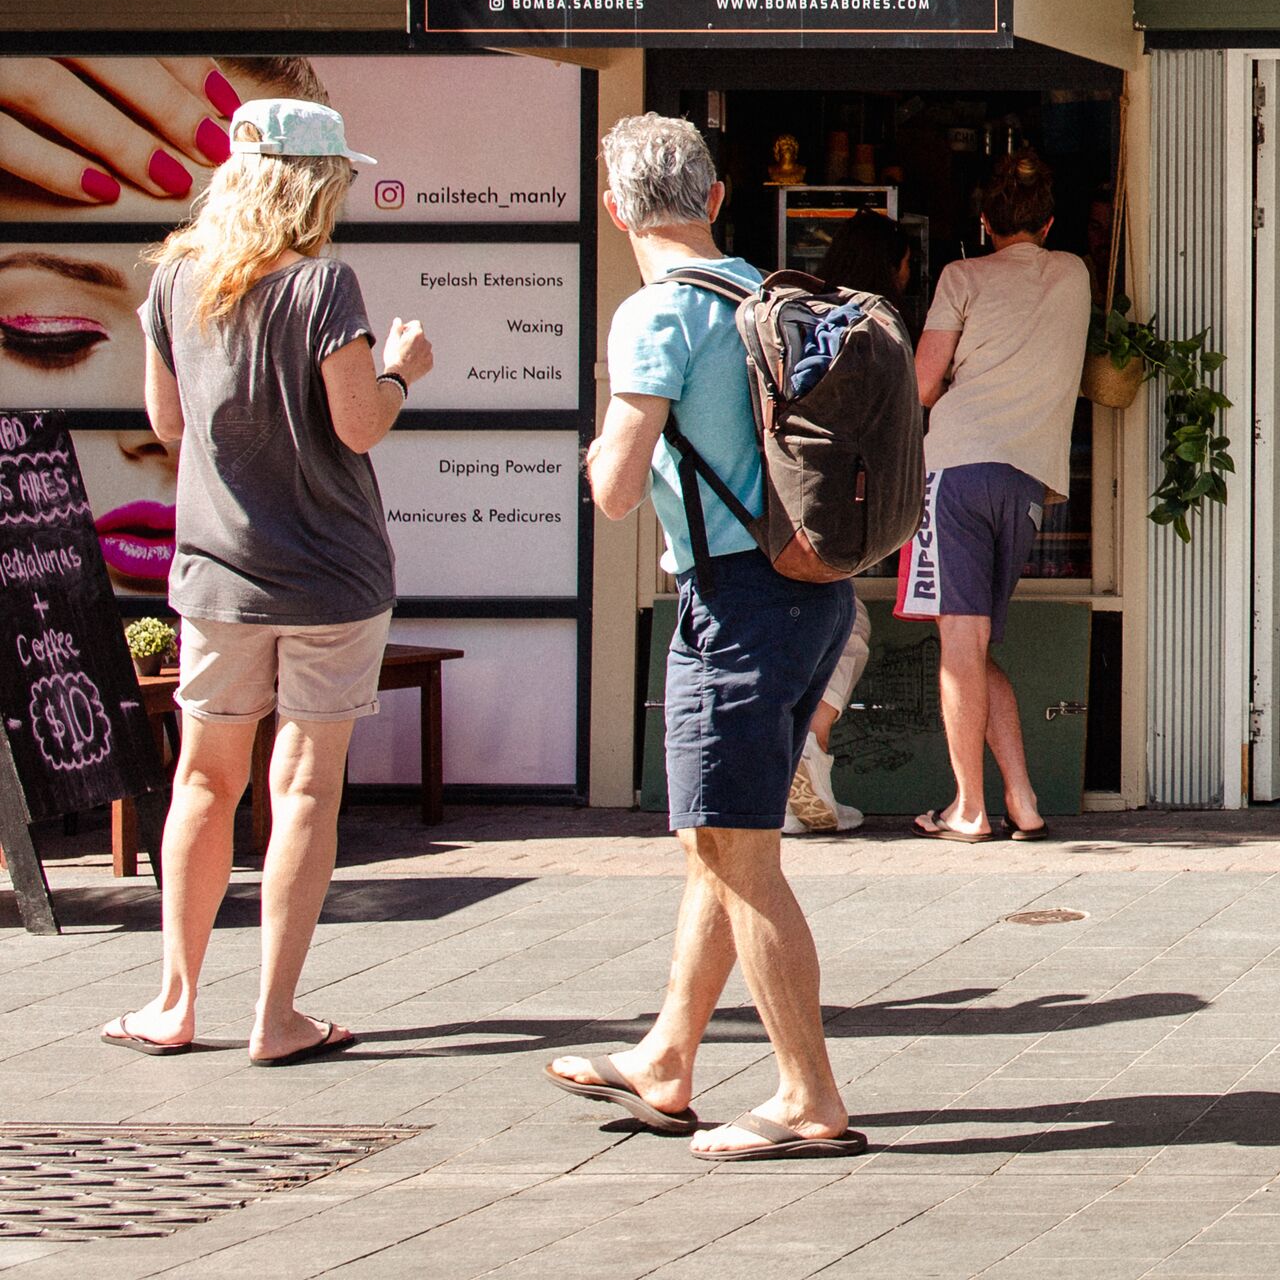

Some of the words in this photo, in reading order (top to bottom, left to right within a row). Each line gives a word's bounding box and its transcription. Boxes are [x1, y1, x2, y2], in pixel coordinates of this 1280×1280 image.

[416, 186, 567, 209] nailstech_manly
[420, 271, 479, 292] Eyelash
[484, 271, 564, 288] Extensions
[506, 319, 564, 338] Waxing
[467, 365, 517, 385] Acrylic
[523, 365, 563, 381] Nails
[439, 459, 500, 478] Dipping
[505, 459, 562, 475] Powder
[19, 468, 70, 507] AIRES
[387, 508, 467, 524] Manicures
[471, 508, 483, 524] &
[489, 508, 562, 524] Pedicures
[0, 542, 82, 587] edialunas
[16, 628, 81, 674] Coffee
[44, 686, 95, 753] $10
